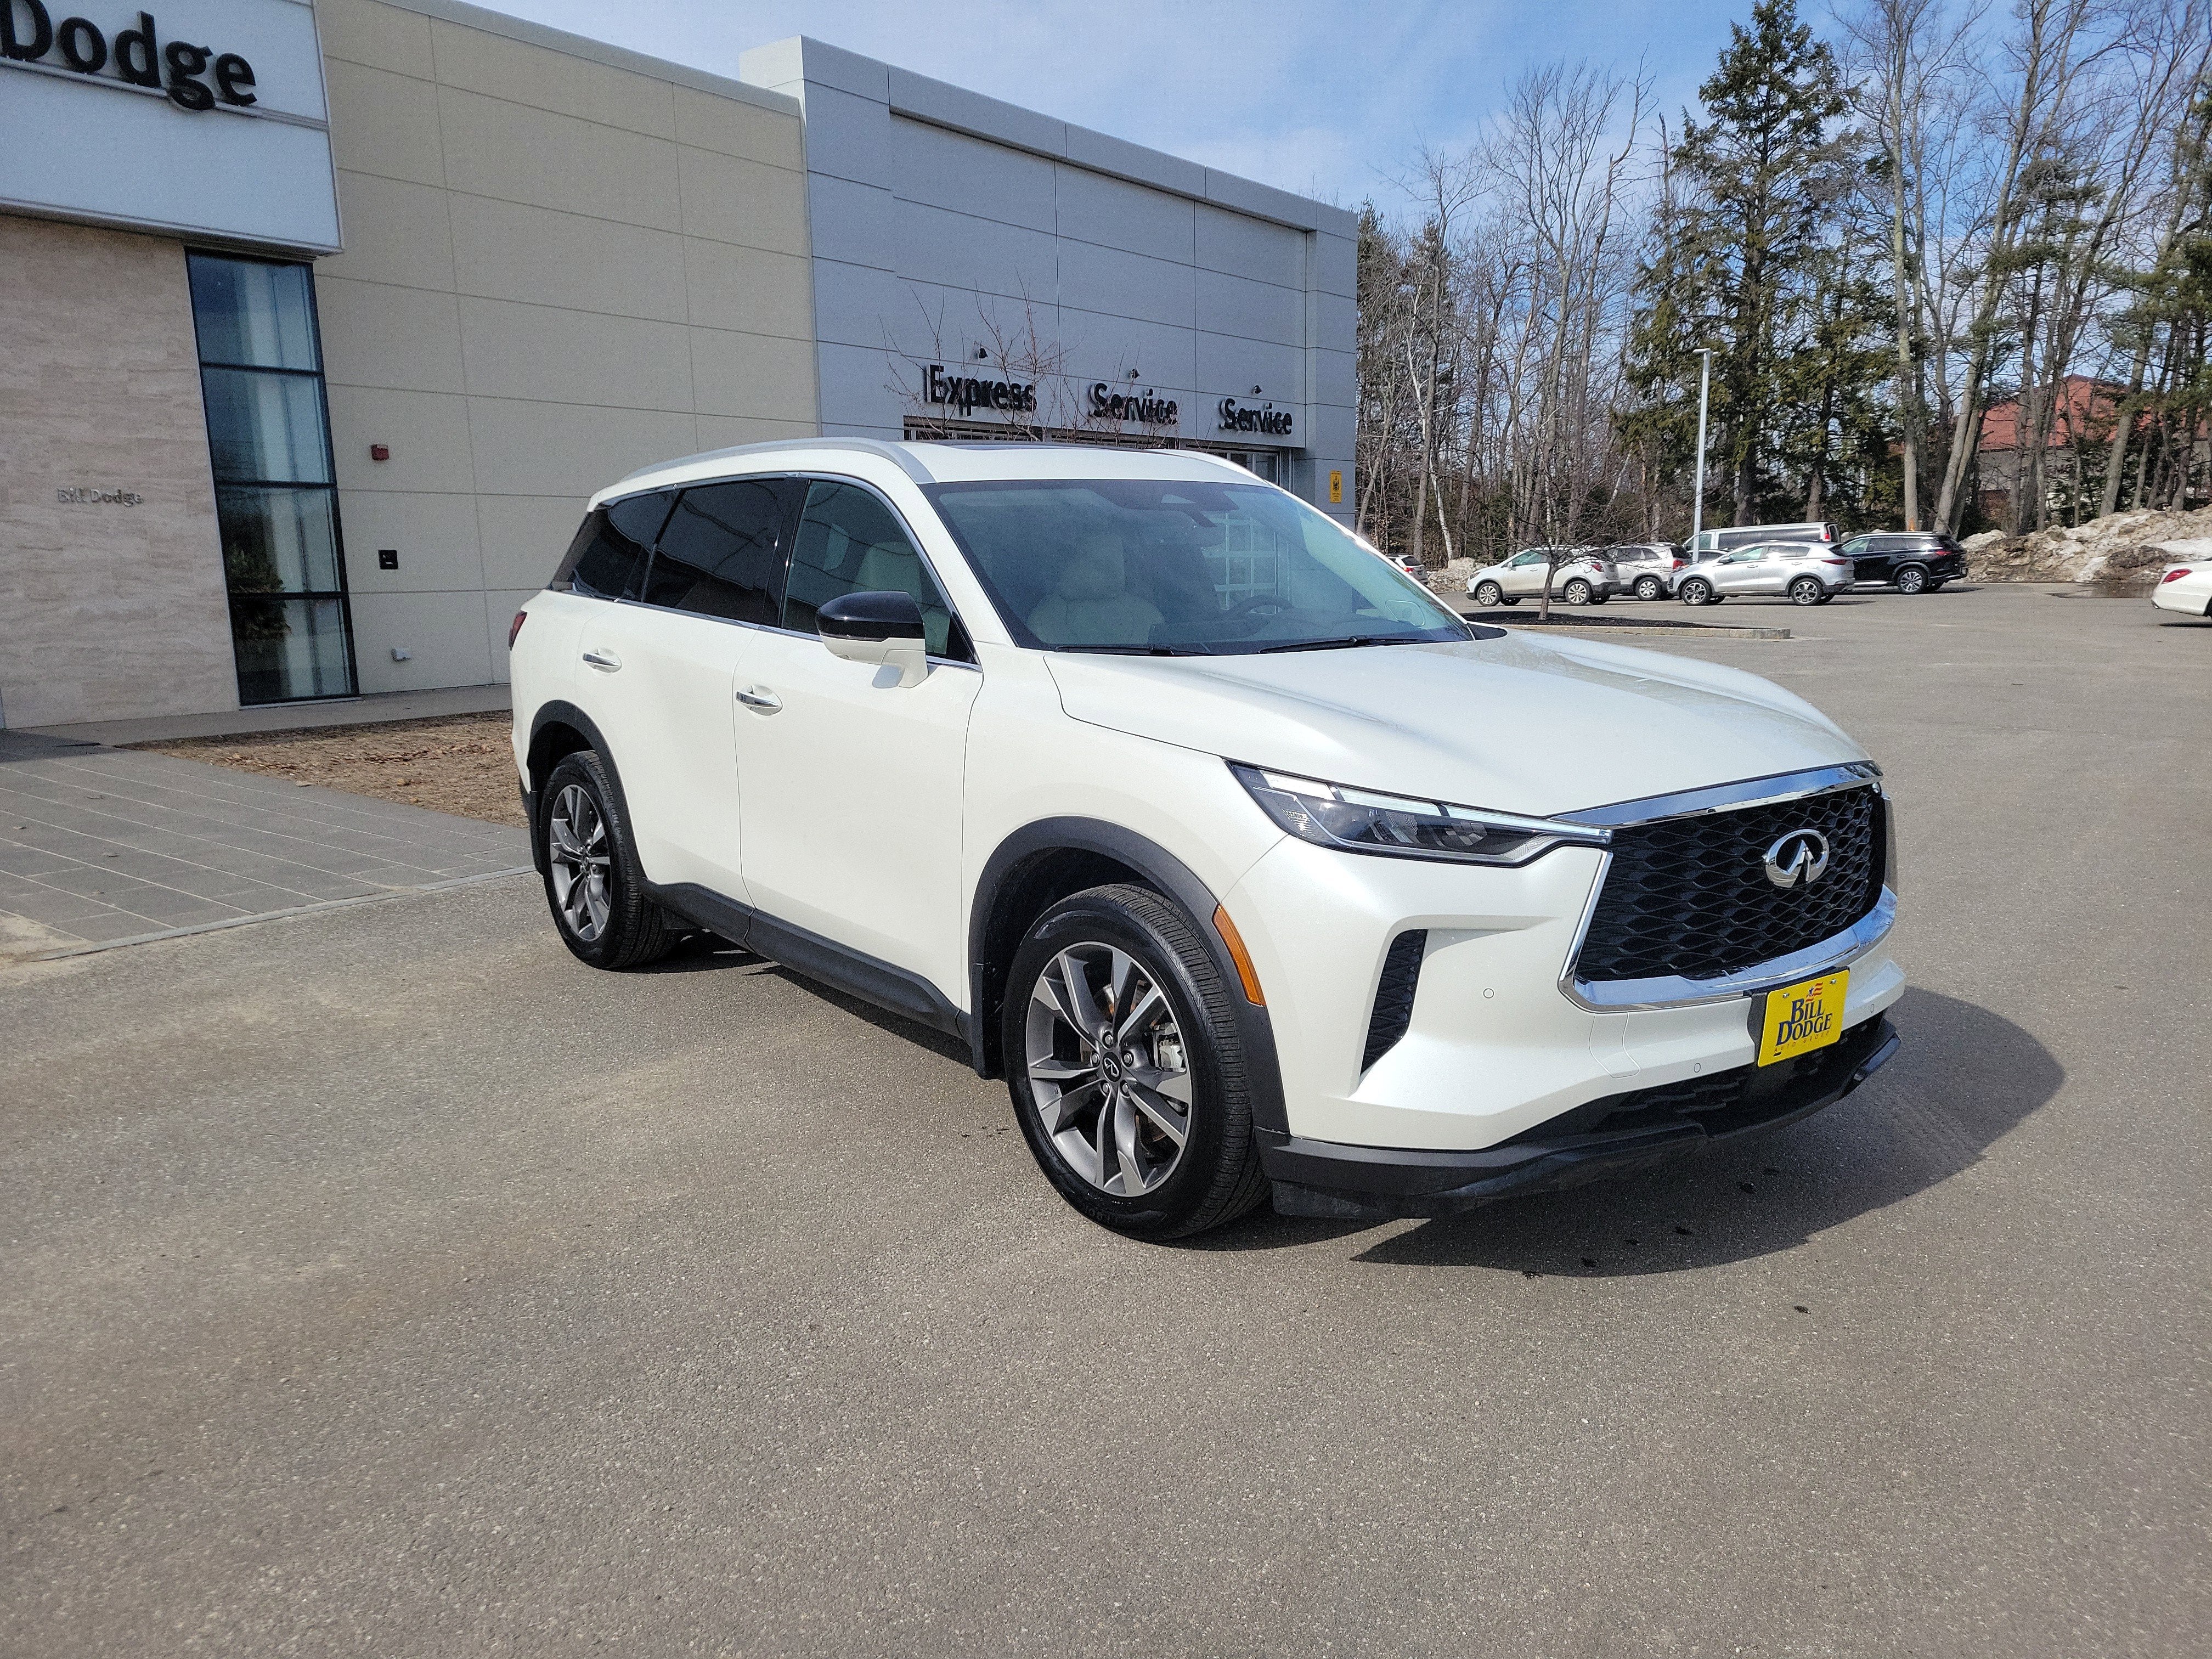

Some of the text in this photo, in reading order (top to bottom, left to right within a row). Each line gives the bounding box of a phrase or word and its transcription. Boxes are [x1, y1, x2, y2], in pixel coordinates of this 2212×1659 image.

[0, 0, 258, 110] Dodge
[926, 364, 1037, 416] Express
[1091, 382, 1178, 425] Service
[1220, 398, 1293, 435] Service
[89, 488, 144, 507] Dodge
[1775, 1013, 1833, 1046] DODGE
[1791, 998, 1825, 1024] BILL
